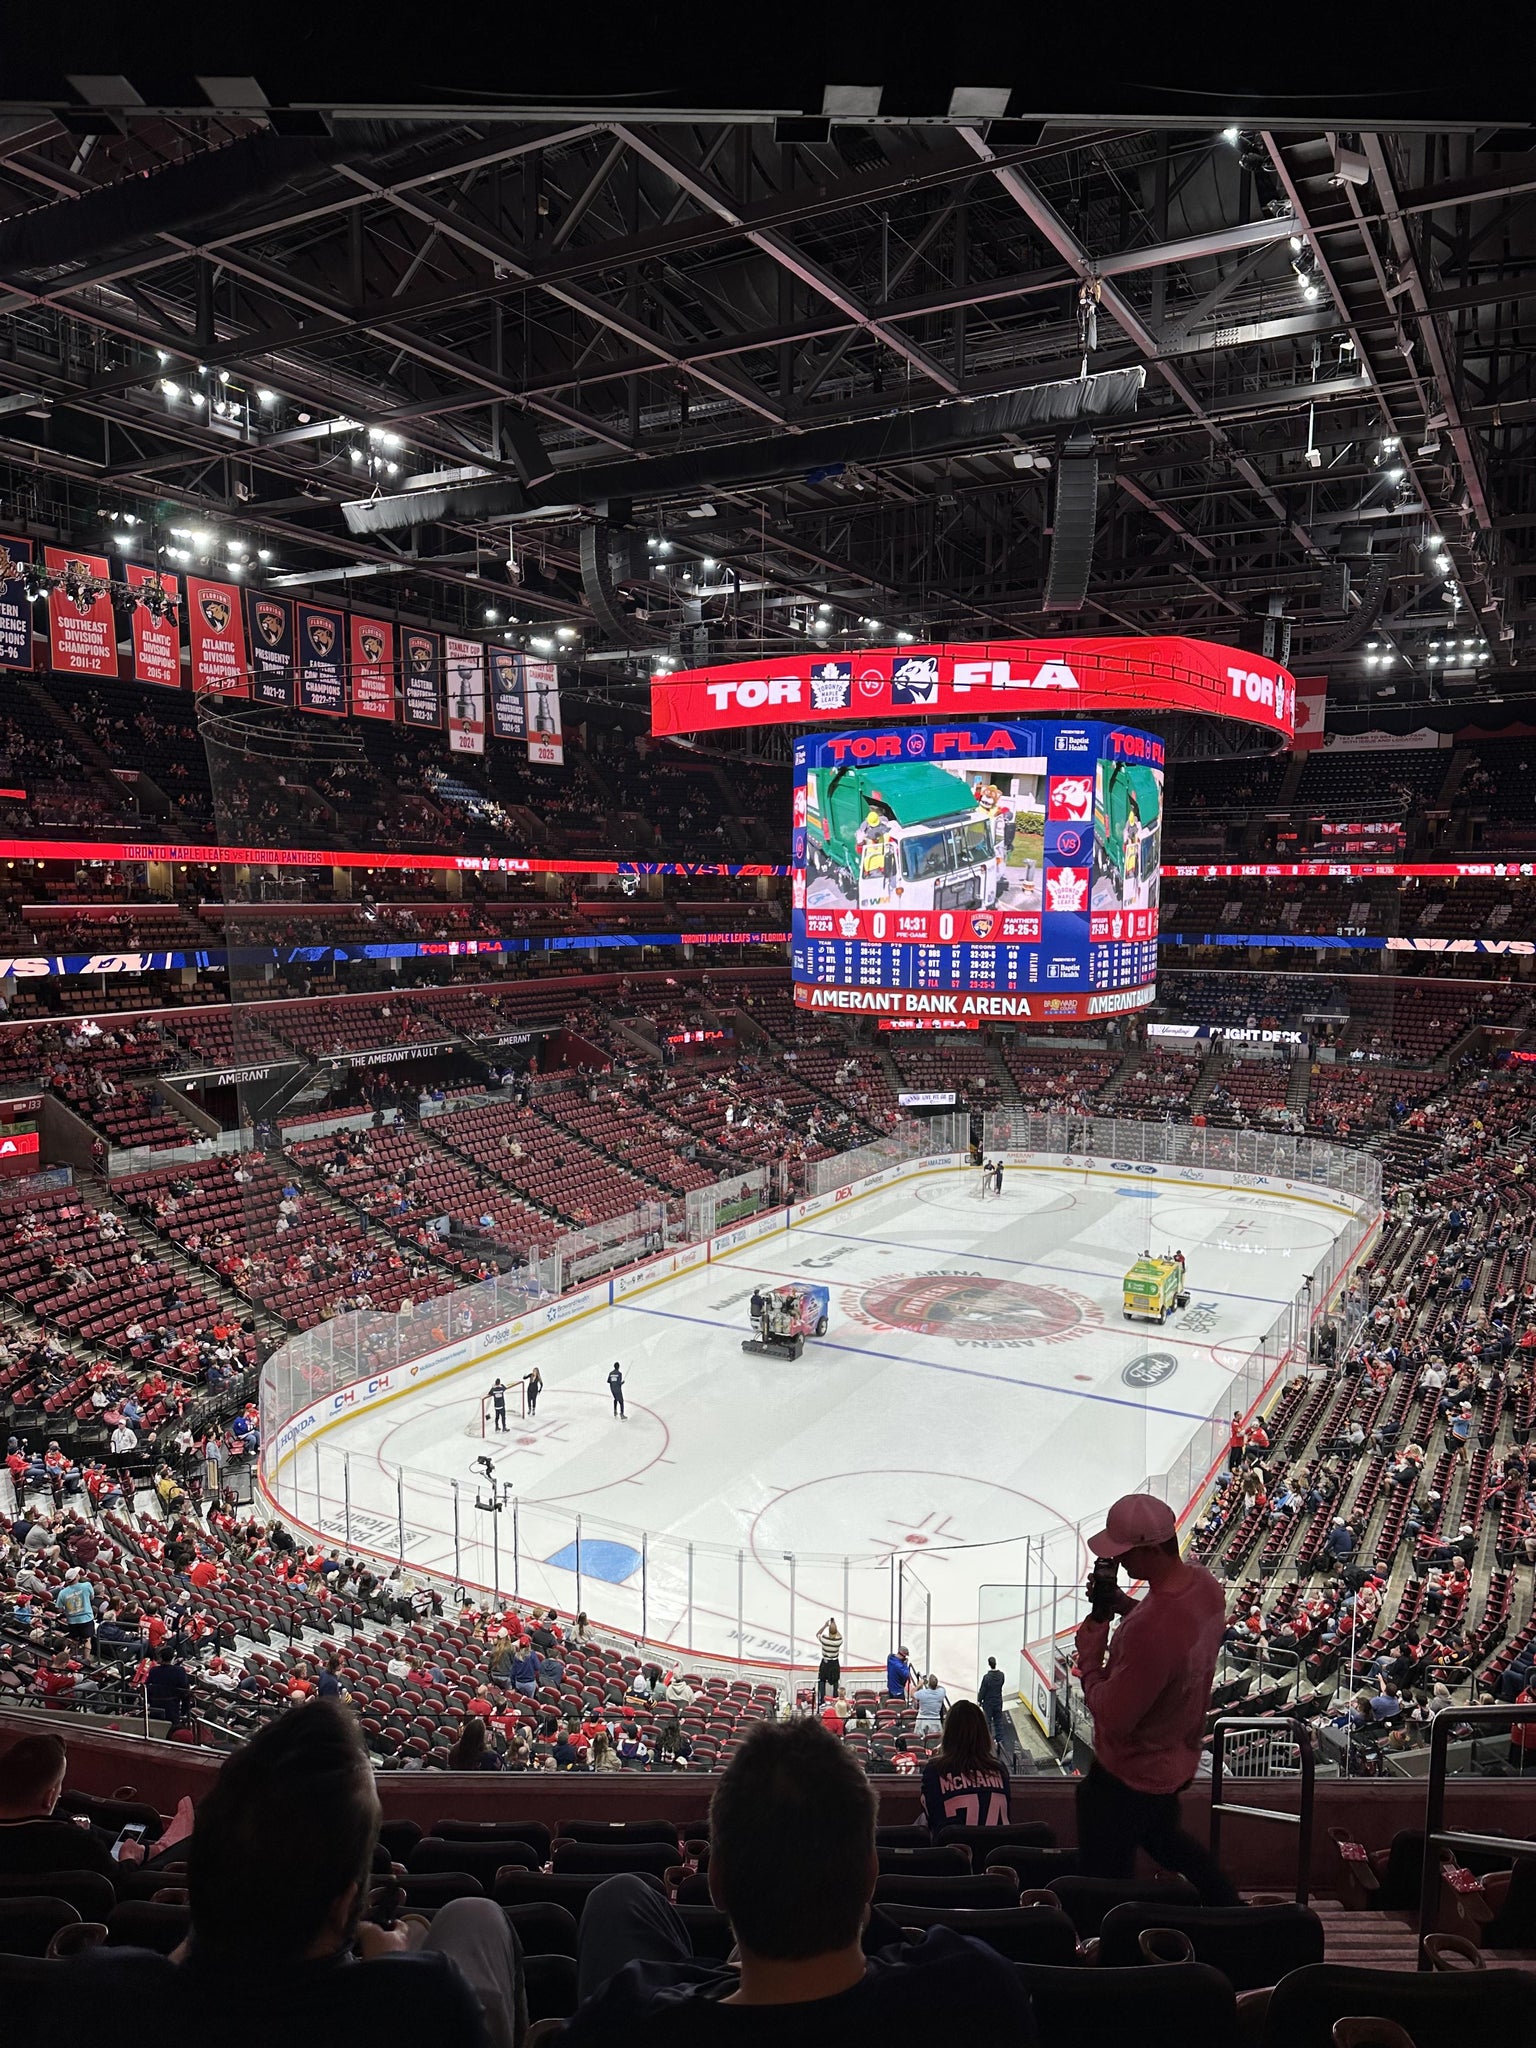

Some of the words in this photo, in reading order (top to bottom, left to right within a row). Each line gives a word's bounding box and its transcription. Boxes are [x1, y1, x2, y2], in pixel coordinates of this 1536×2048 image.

[202, 592, 227, 603] FLORIDA
[259, 606, 282, 616] FLORIDA
[58, 617, 107, 633] SOUTHEAST
[310, 619, 332, 630] FLORIDA
[64, 630, 103, 645] DIVISION
[142, 631, 171, 646] ATLANTIC
[58, 641, 110, 657] CHAMPIONS
[143, 643, 170, 657] DIVISION
[202, 638, 235, 652] ATLANTIC
[448, 641, 468, 652] STANLEY
[470, 645, 480, 655] CUP
[70, 656, 101, 669] 2011-12
[139, 652, 176, 669] CHAMPIONS
[203, 651, 235, 664] DIVISION
[255, 648, 290, 665] PRESIDENTS'
[147, 667, 171, 680] 2015-16
[199, 663, 241, 676] CHAMPIONS
[529, 670, 554, 682] CHAMPIONS
[306, 682, 340, 696] CHAMPIONS
[361, 680, 386, 691] DIVISION
[411, 678, 433, 690] EASTERN
[706, 675, 801, 711] TOR
[864, 678, 879, 689] VS
[953, 659, 1080, 693] FLA
[817, 683, 844, 694] TORONTO
[1227, 667, 1273, 707] TOR
[263, 685, 285, 699] 2021-22
[408, 698, 436, 712] CHAMPIONS
[500, 694, 520, 705] EASTERN
[362, 702, 386, 713] 2023-24
[496, 703, 524, 716] CONFERENCE
[412, 709, 433, 721] 2023-24
[497, 713, 524, 724] CHAMPIONS
[459, 736, 475, 749] 2024
[827, 735, 901, 759] TOR
[910, 740, 922, 749] VS
[933, 730, 1016, 753] FLA
[1069, 737, 1089, 745] Baptist
[1069, 743, 1088, 751] Health
[538, 748, 554, 760] 2025
[1110, 731, 1144, 758] TOR
[1152, 742, 1164, 766] FL
[1062, 838, 1076, 849] VS
[122, 845, 166, 859] TORONTO
[169, 846, 200, 860] MAPLE
[202, 847, 230, 861] LEAFS
[245, 850, 279, 863] FLORIDA
[281, 851, 322, 864] PANTHERS
[455, 857, 480, 869] TOR
[508, 859, 529, 870] FLA
[1226, 865, 1232, 875] 0
[1292, 865, 1298, 875] 0
[1456, 865, 1491, 874] TOR
[1054, 887, 1080, 896] TORONTO
[870, 896, 890, 905] WM
[808, 921, 833, 932] 27-22-9
[873, 912, 886, 939] 0
[899, 917, 926, 931] 14:31
[939, 912, 953, 940] 0
[1003, 924, 1039, 936] 29-25-3
[681, 934, 707, 944] TORONTO
[708, 933, 729, 943] MAPLE
[730, 933, 750, 943] LEAFS
[761, 932, 786, 942] FLORIDA
[420, 943, 448, 955] TOR
[478, 941, 502, 952] FLA
[1481, 940, 1536, 955] VS
[892, 968, 900, 976] 72
[1029, 952, 1038, 983] ATLANTIC
[1060, 964, 1080, 972] Baptist
[892, 978, 900, 986] 72
[810, 989, 904, 1011] AMERANT
[906, 994, 958, 1013] BANK
[962, 996, 1031, 1016] ARENA
[1087, 988, 1138, 1015] AMERANT
[890, 1020, 913, 1028] TOR
[943, 1020, 966, 1028] FLA
[498, 1034, 531, 1046] AMERANT
[668, 1035, 684, 1043] TOR
[705, 1030, 723, 1039] FLA
[1262, 1029, 1302, 1043] DECK
[350, 1056, 366, 1067] THE
[368, 1052, 410, 1065] AMERANT
[411, 1047, 438, 1060] VAULT
[218, 1069, 269, 1085] AMERANT
[29, 1101, 41, 1109] 133
[1233, 1173, 1258, 1181] OMEGA
[1233, 1178, 1256, 1187] SPORT
[1256, 1176, 1269, 1185] XL
[835, 1185, 853, 1202] DEX
[859, 1272, 907, 1287] BANK
[914, 1269, 983, 1278] ARENA
[839, 1288, 898, 1331] AMERANT
[1035, 1282, 1105, 1325] AMERANT
[1192, 1313, 1222, 1334] SPORT
[1043, 1326, 1094, 1345] BANK
[954, 1338, 1037, 1349] ARENA
[1130, 1358, 1171, 1383] Ford
[368, 1376, 389, 1393] CH
[334, 1390, 354, 1409] CH
[280, 1415, 315, 1447] HONDA
[335, 1510, 394, 1533] Health
[727, 1630, 755, 1643] LINE
[758, 1639, 802, 1657] CRUISE
[939, 1769, 1004, 1794] McMANN
